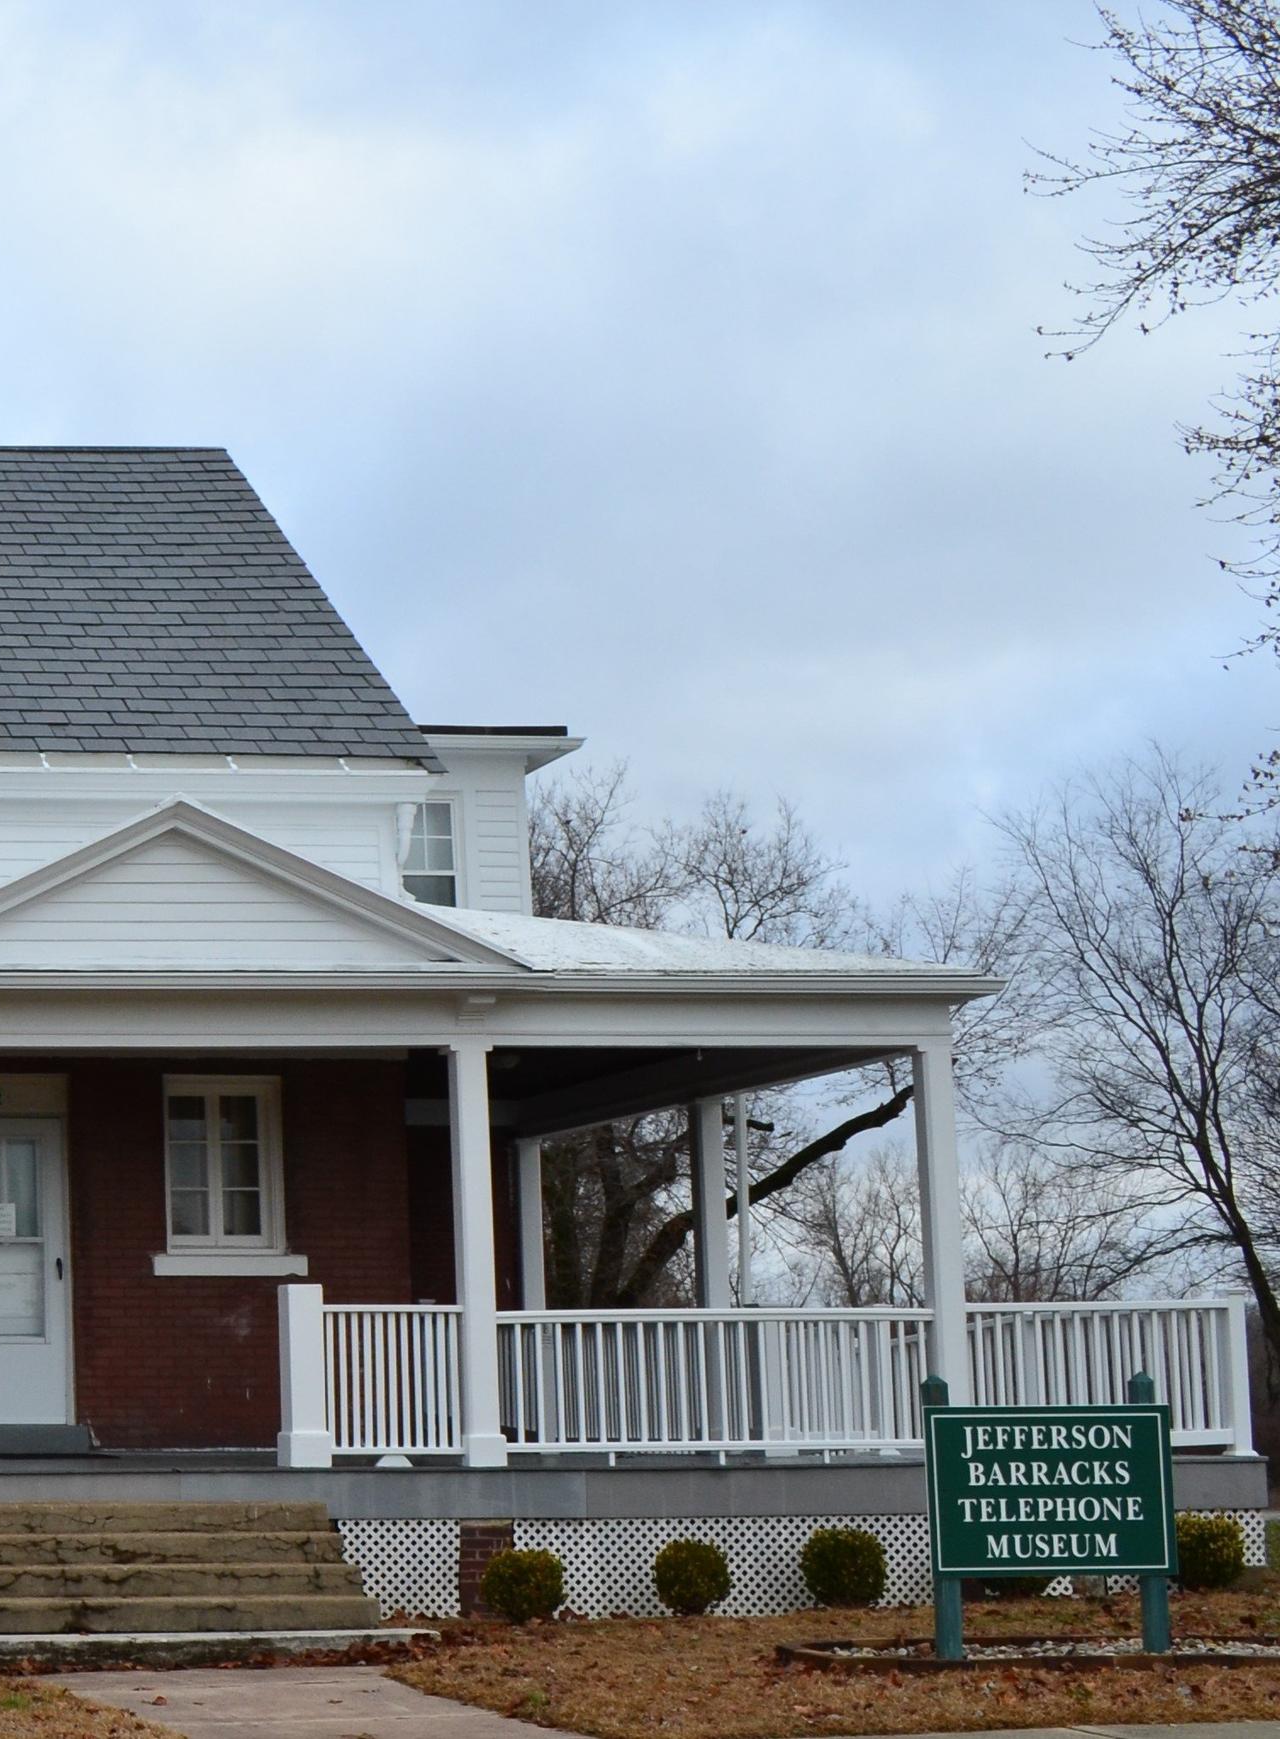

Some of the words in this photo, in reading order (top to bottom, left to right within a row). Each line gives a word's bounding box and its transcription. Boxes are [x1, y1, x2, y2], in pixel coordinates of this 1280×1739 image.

[960, 1424, 1133, 1459] JEFFERSON
[968, 1460, 1130, 1487] BARRACKS
[957, 1496, 1144, 1523] TELEPHONE
[986, 1533, 1118, 1559] MUSEUM
